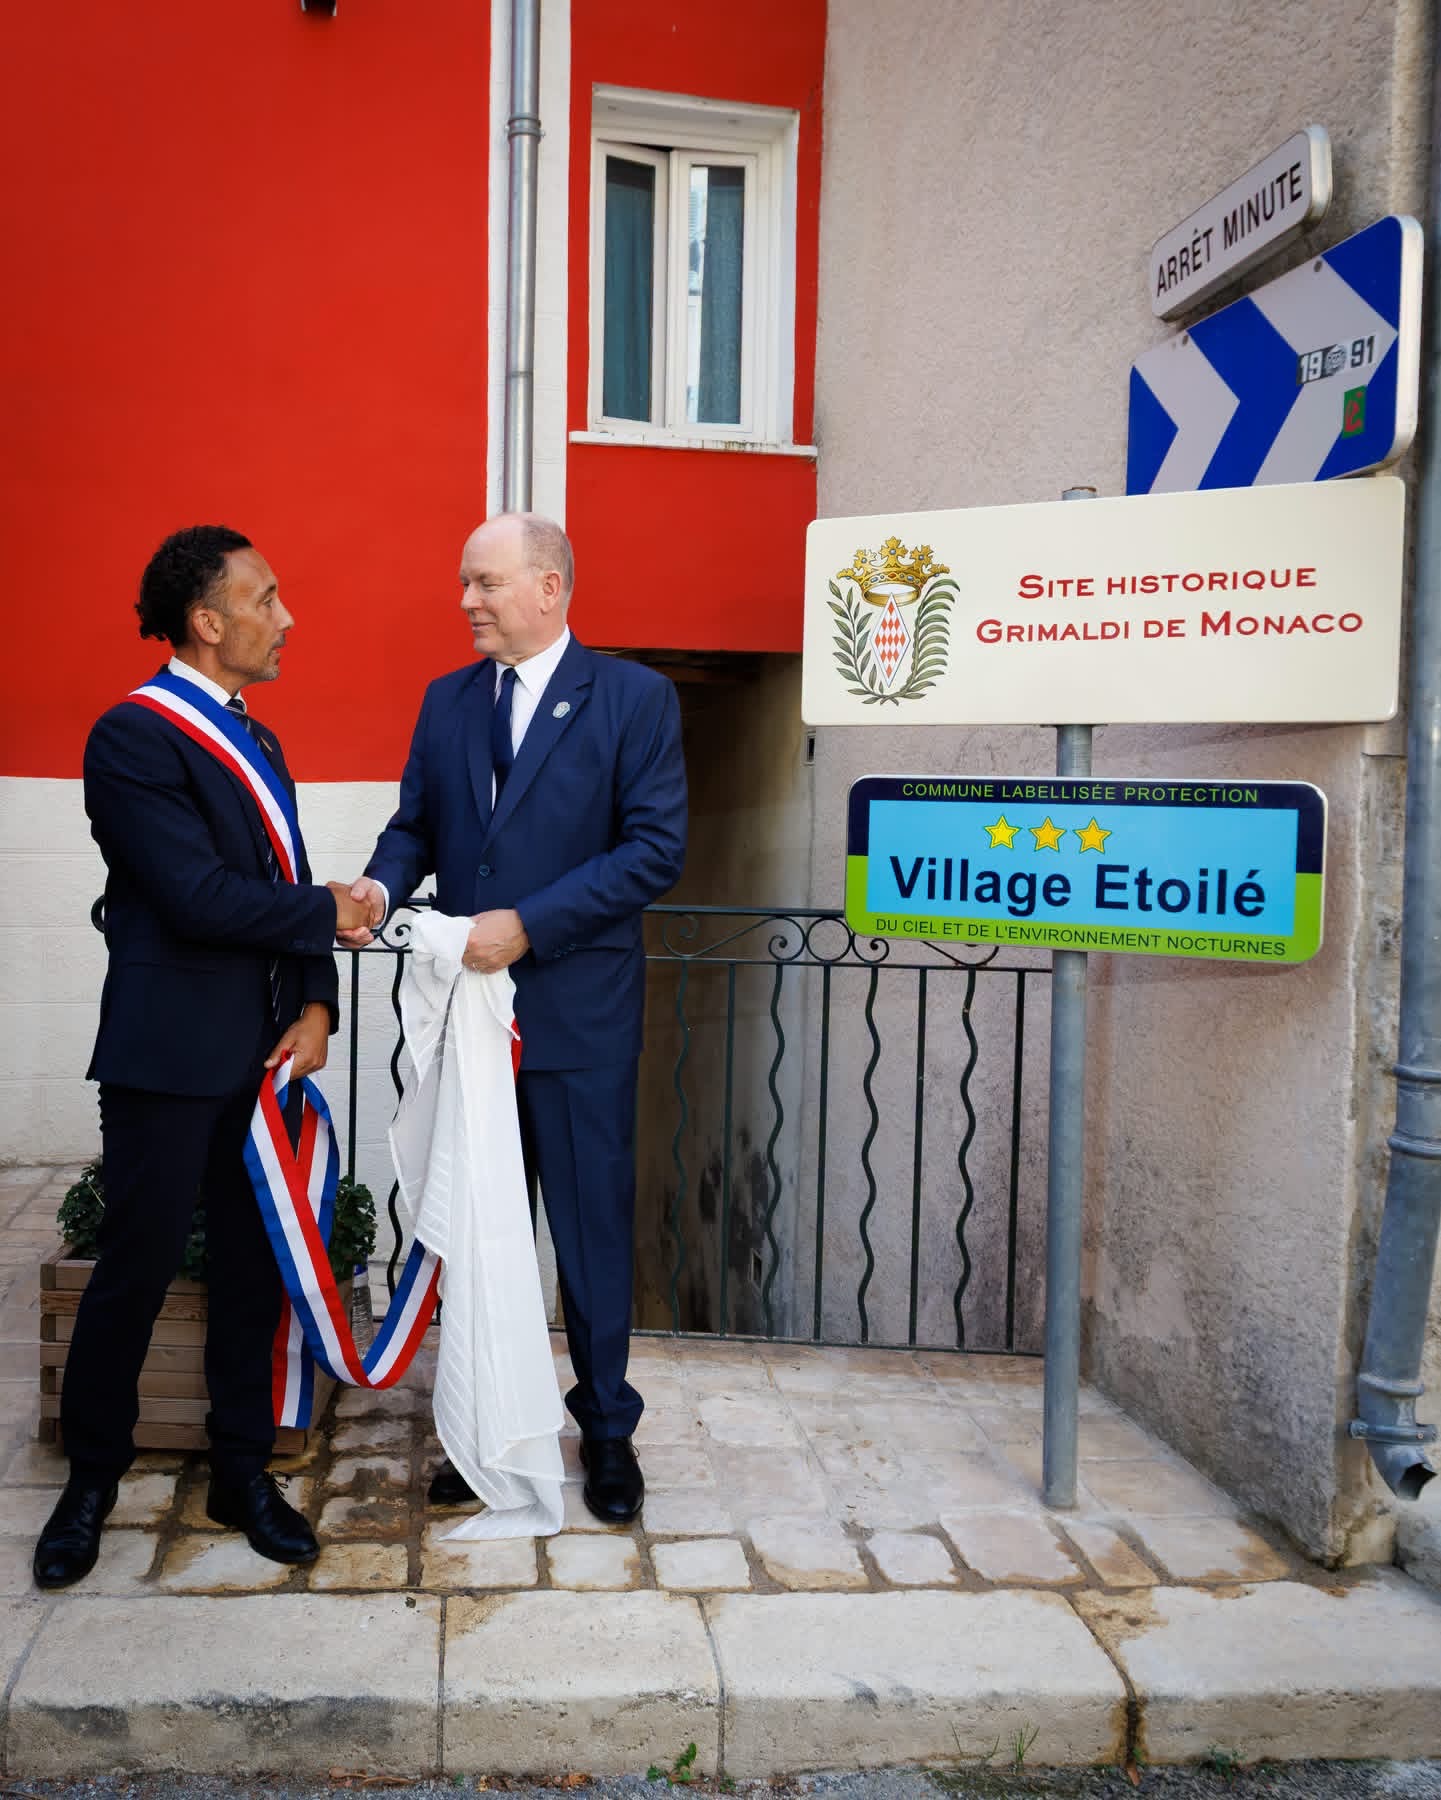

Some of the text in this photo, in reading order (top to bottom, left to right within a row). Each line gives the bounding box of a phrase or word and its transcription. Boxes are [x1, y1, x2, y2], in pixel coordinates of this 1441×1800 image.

[1223, 162, 1303, 250] MINUTE
[1106, 567, 1317, 595] HISTORIQUE
[902, 783, 1258, 803] COMMUNE LABELLISÉE PROTECTION
[889, 855, 1266, 917] Village Etoilé
[875, 918, 1286, 956] DU CIEL ET DE L'ENVIRONNEMENT NOCTURNES
